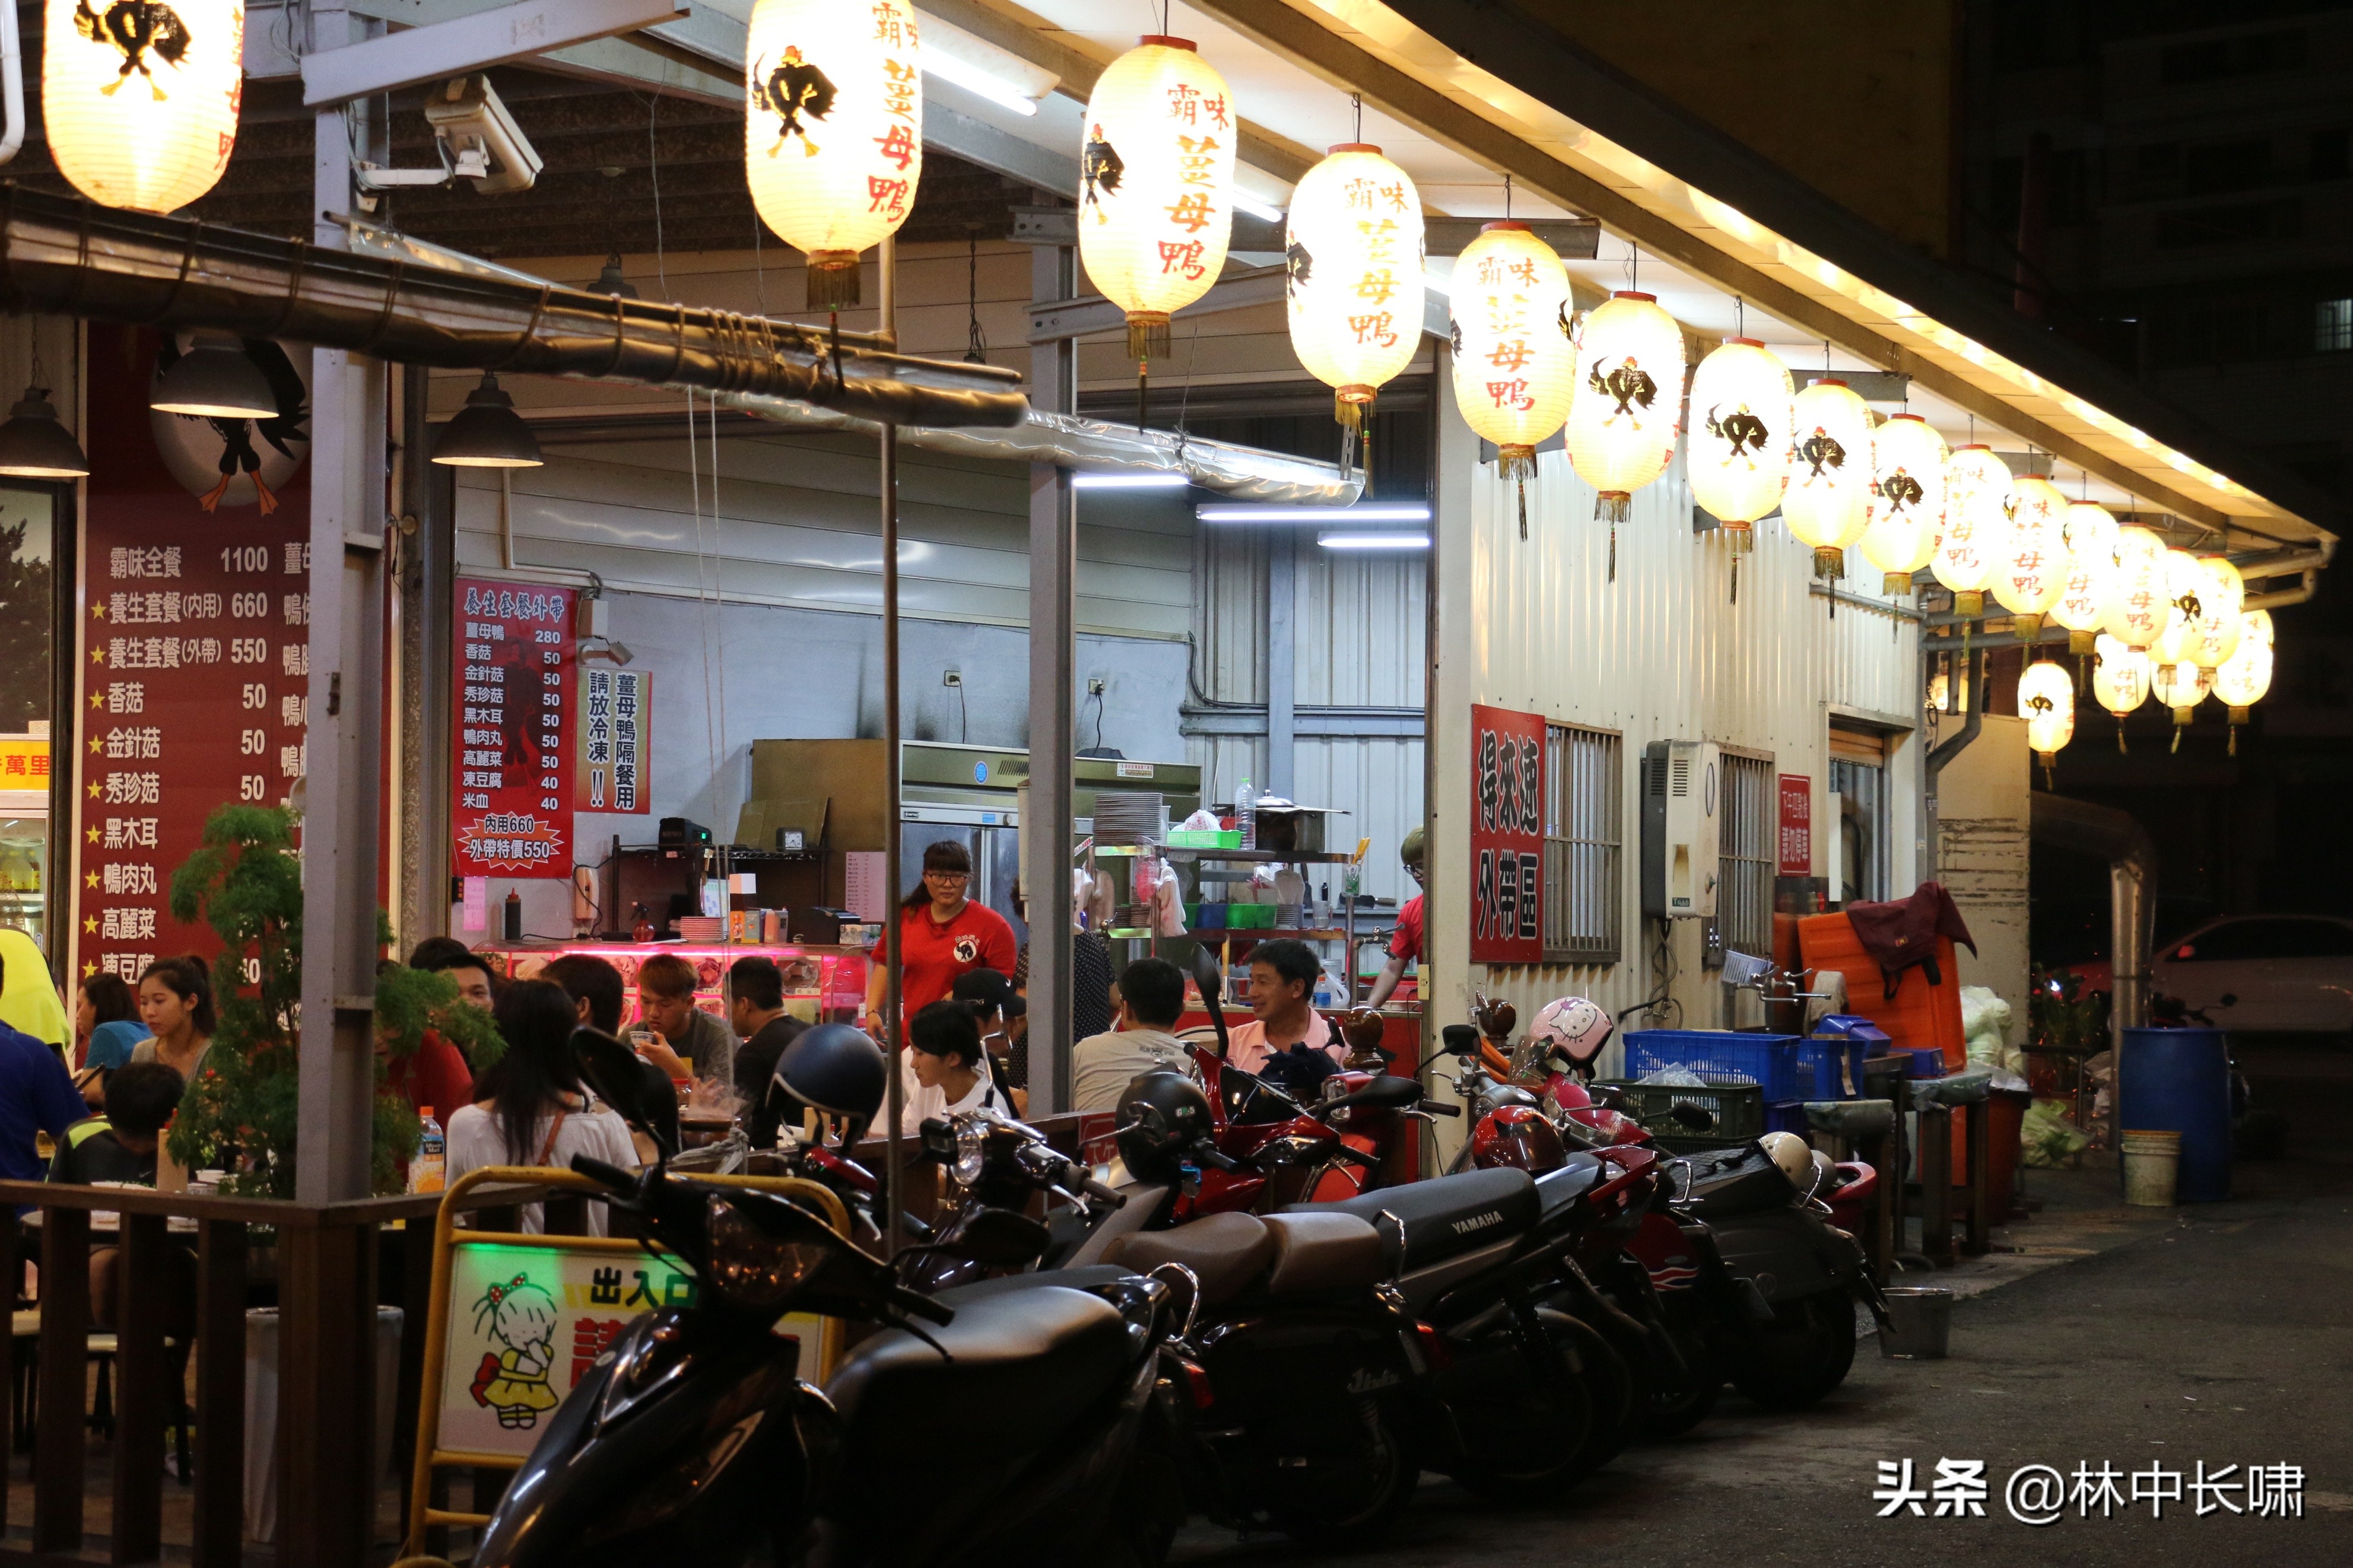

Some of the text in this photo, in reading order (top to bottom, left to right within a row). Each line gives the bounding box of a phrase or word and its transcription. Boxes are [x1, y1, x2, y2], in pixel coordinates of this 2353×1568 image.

[1167, 84, 1229, 131] 霸味
[1158, 134, 1220, 281] 薑母鴨
[1344, 178, 1409, 214] 霸味
[1477, 257, 1541, 288] 霸味
[110, 546, 182, 579] 霸味全餐
[221, 546, 268, 573] 1100
[231, 593, 268, 618] 660
[464, 587, 564, 623] 養生套餐外帶
[465, 622, 561, 644] 薑母鴨 280
[231, 638, 267, 663] 550
[465, 643, 561, 665] 香菇 50
[465, 664, 560, 685] 金針菇 50
[108, 682, 144, 714] 香菇
[242, 683, 266, 709] 50
[464, 686, 560, 706] 秀珍菇 50
[463, 708, 560, 727] 黑木耳 50
[107, 727, 161, 759] 金針菇
[241, 729, 265, 755] 50
[463, 729, 559, 748] 鴨肉丸 50
[615, 673, 637, 809] 薑母鴨隔餐用
[0, 754, 49, 775] 萬里
[463, 749, 558, 768] 高麗菜 50
[106, 772, 265, 804] 秀珍菇 50
[462, 771, 558, 790] 凍豆腐 40
[1478, 728, 1540, 836] 得來速
[462, 792, 558, 810] 米血 40
[104, 817, 158, 849] 黑木耳
[469, 838, 551, 859] 外帶特價550
[104, 862, 157, 894] 鴨肉丸
[1477, 848, 1539, 941] 外帶區
[102, 907, 156, 940] 高麗菜
[1452, 1211, 1503, 1234] YAMAHA
[591, 1266, 698, 1309] 出入口
